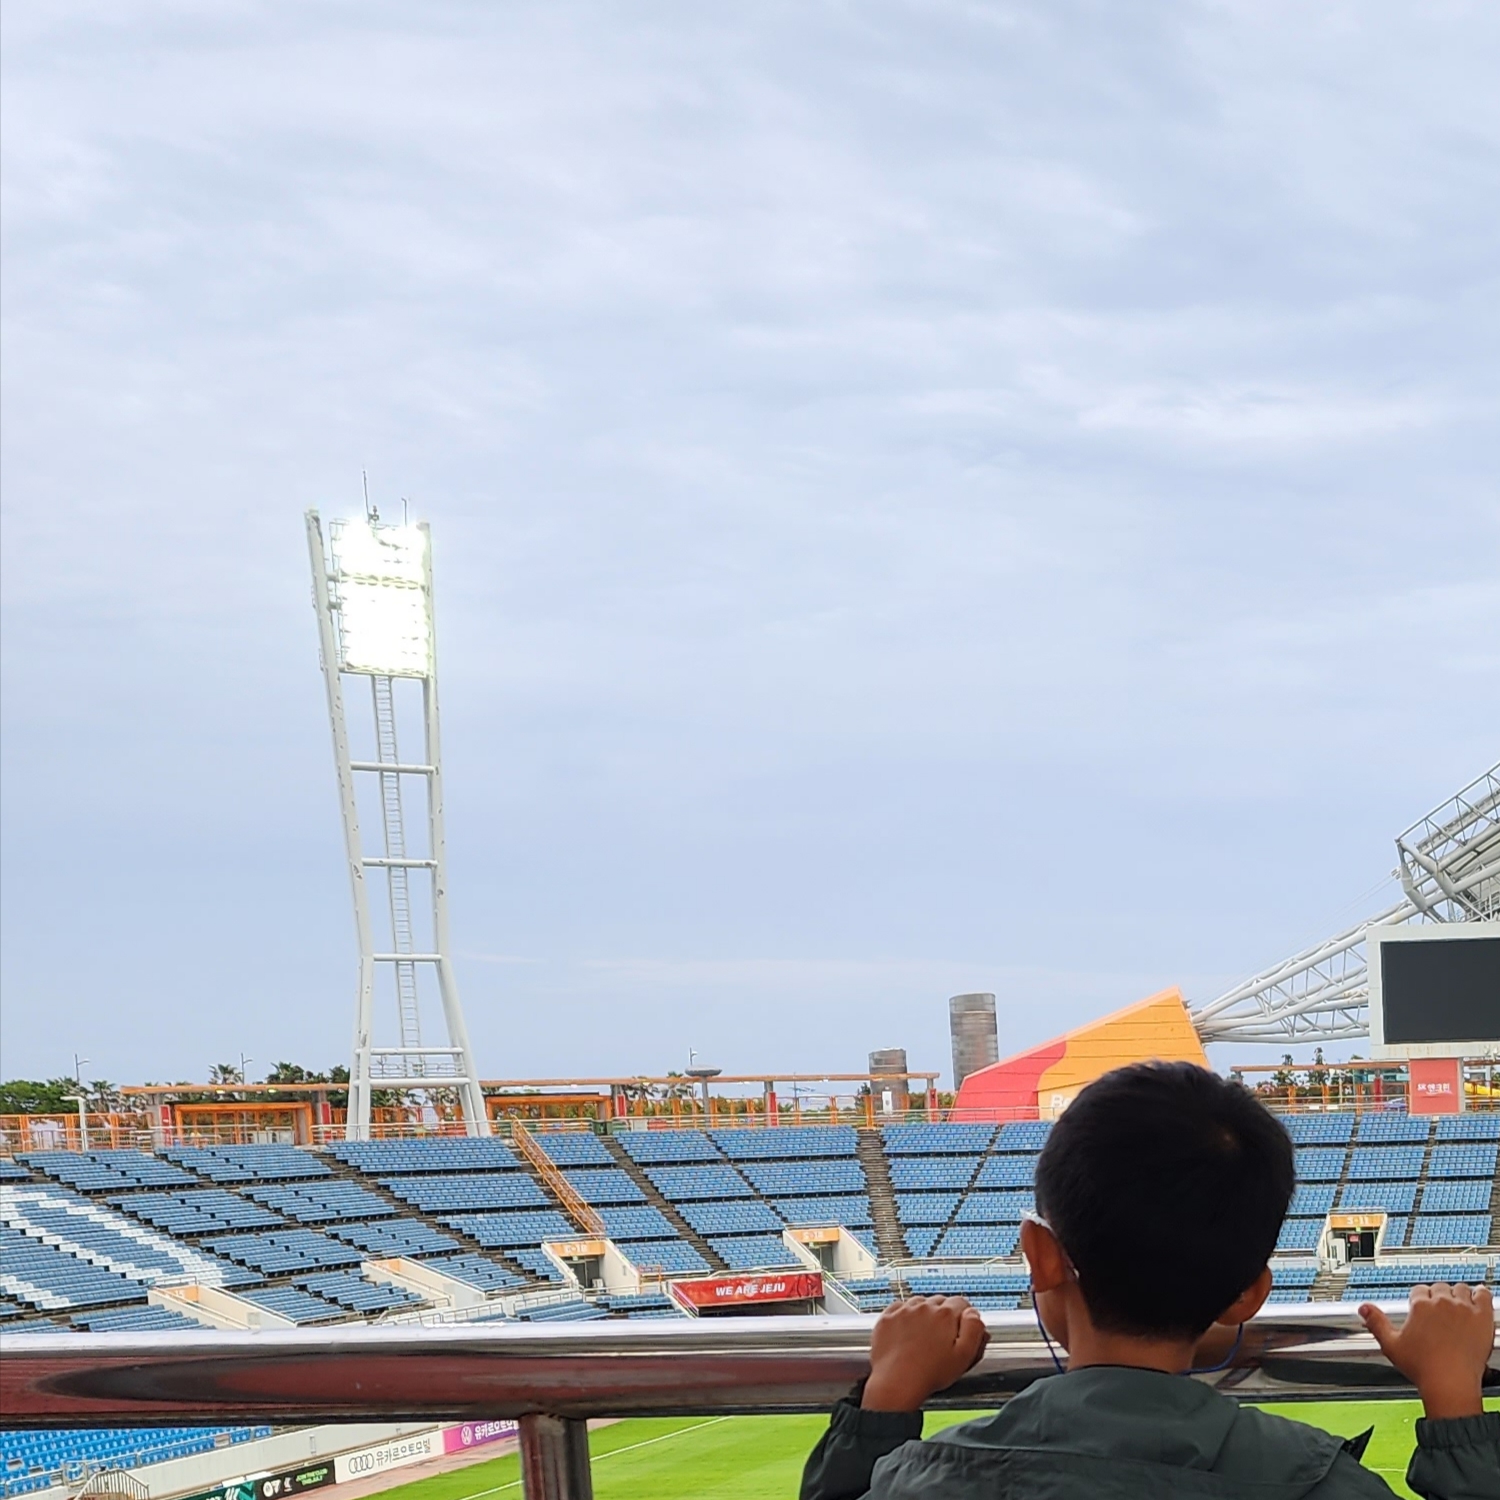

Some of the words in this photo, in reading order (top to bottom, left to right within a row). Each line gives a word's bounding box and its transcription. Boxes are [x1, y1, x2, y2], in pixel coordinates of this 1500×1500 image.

[715, 1285, 733, 1297] WE
[735, 1284, 758, 1296] ARE
[759, 1282, 786, 1294] JEJU
[376, 1439, 431, 1466] 유카르오토모빌
